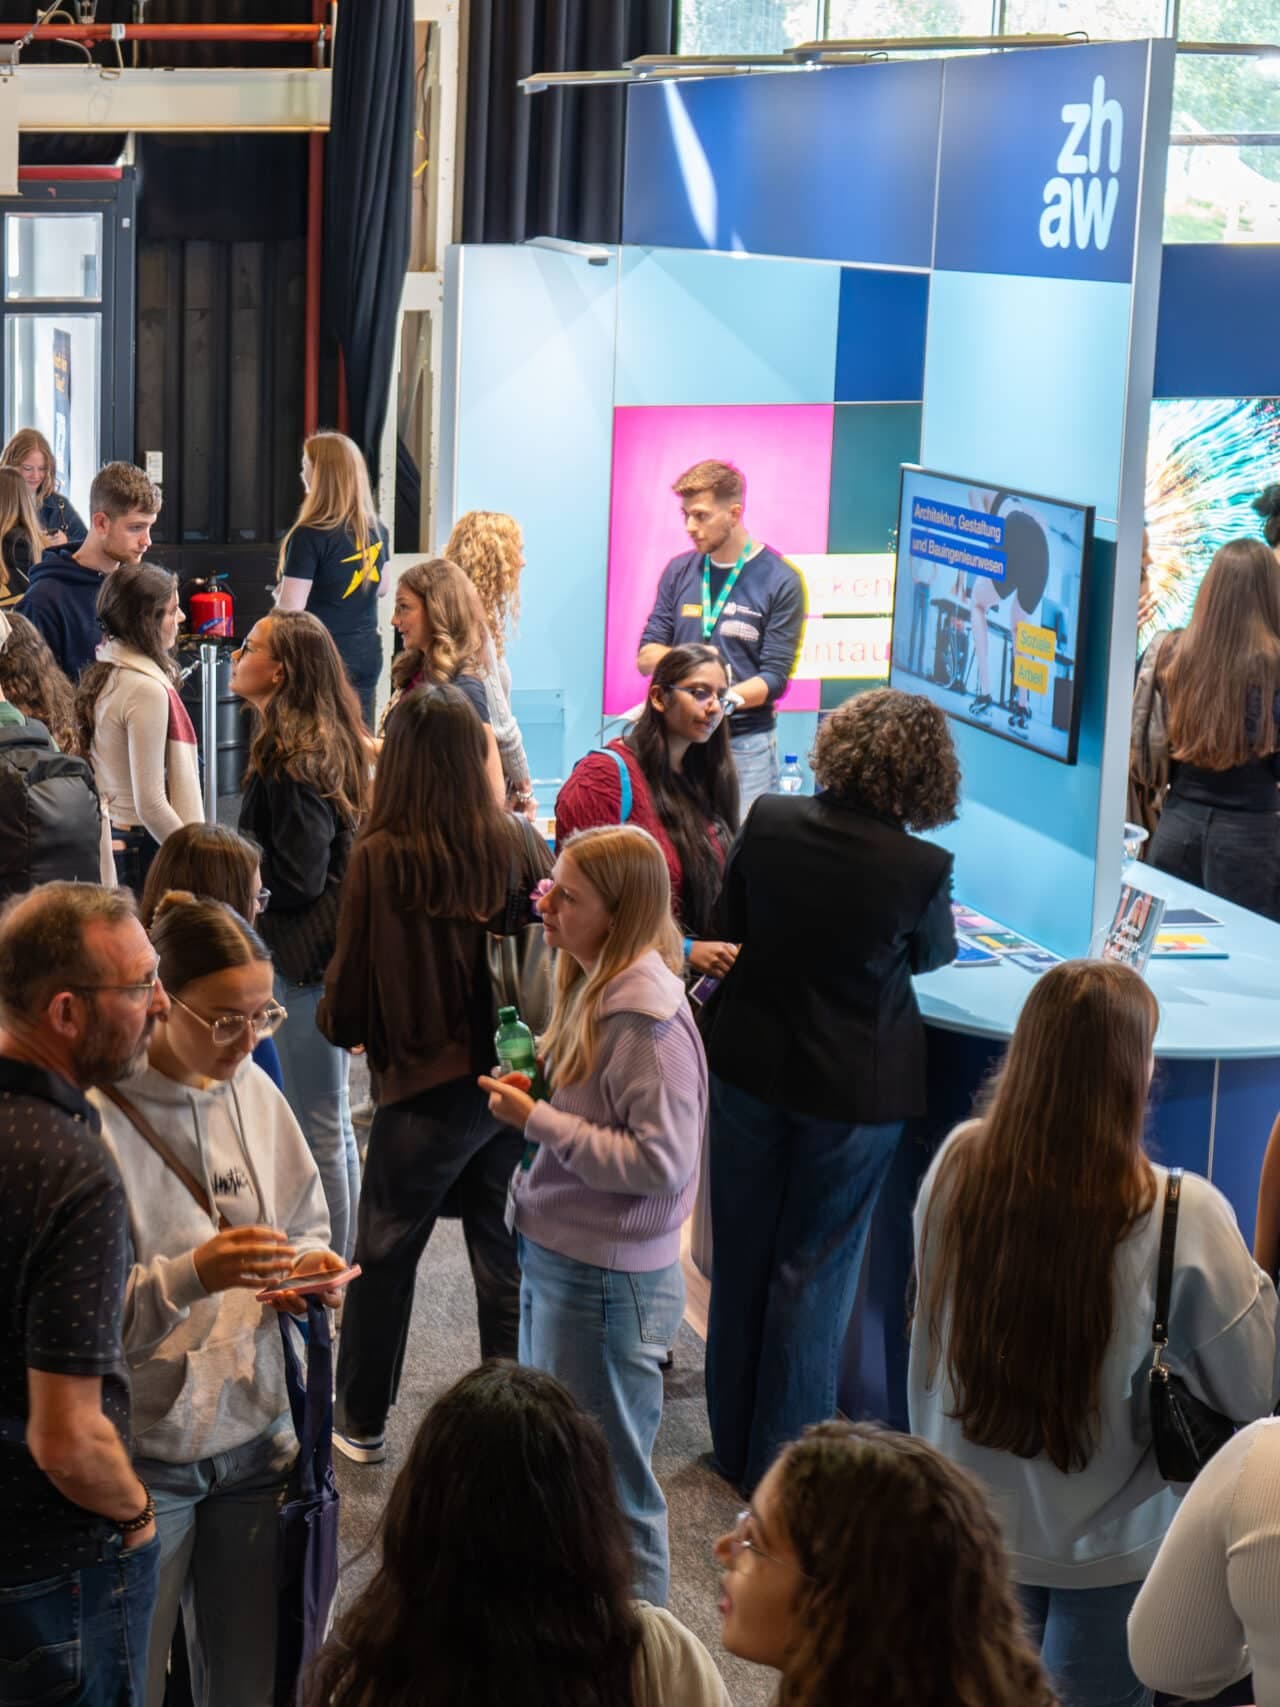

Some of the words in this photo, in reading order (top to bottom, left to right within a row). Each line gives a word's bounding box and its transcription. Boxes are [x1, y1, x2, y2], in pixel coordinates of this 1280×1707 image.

[914, 503, 956, 530] Architektur,
[958, 513, 1002, 544] Gestaltung
[911, 539, 927, 553] und
[928, 539, 1005, 576] Bauingenieurwesen
